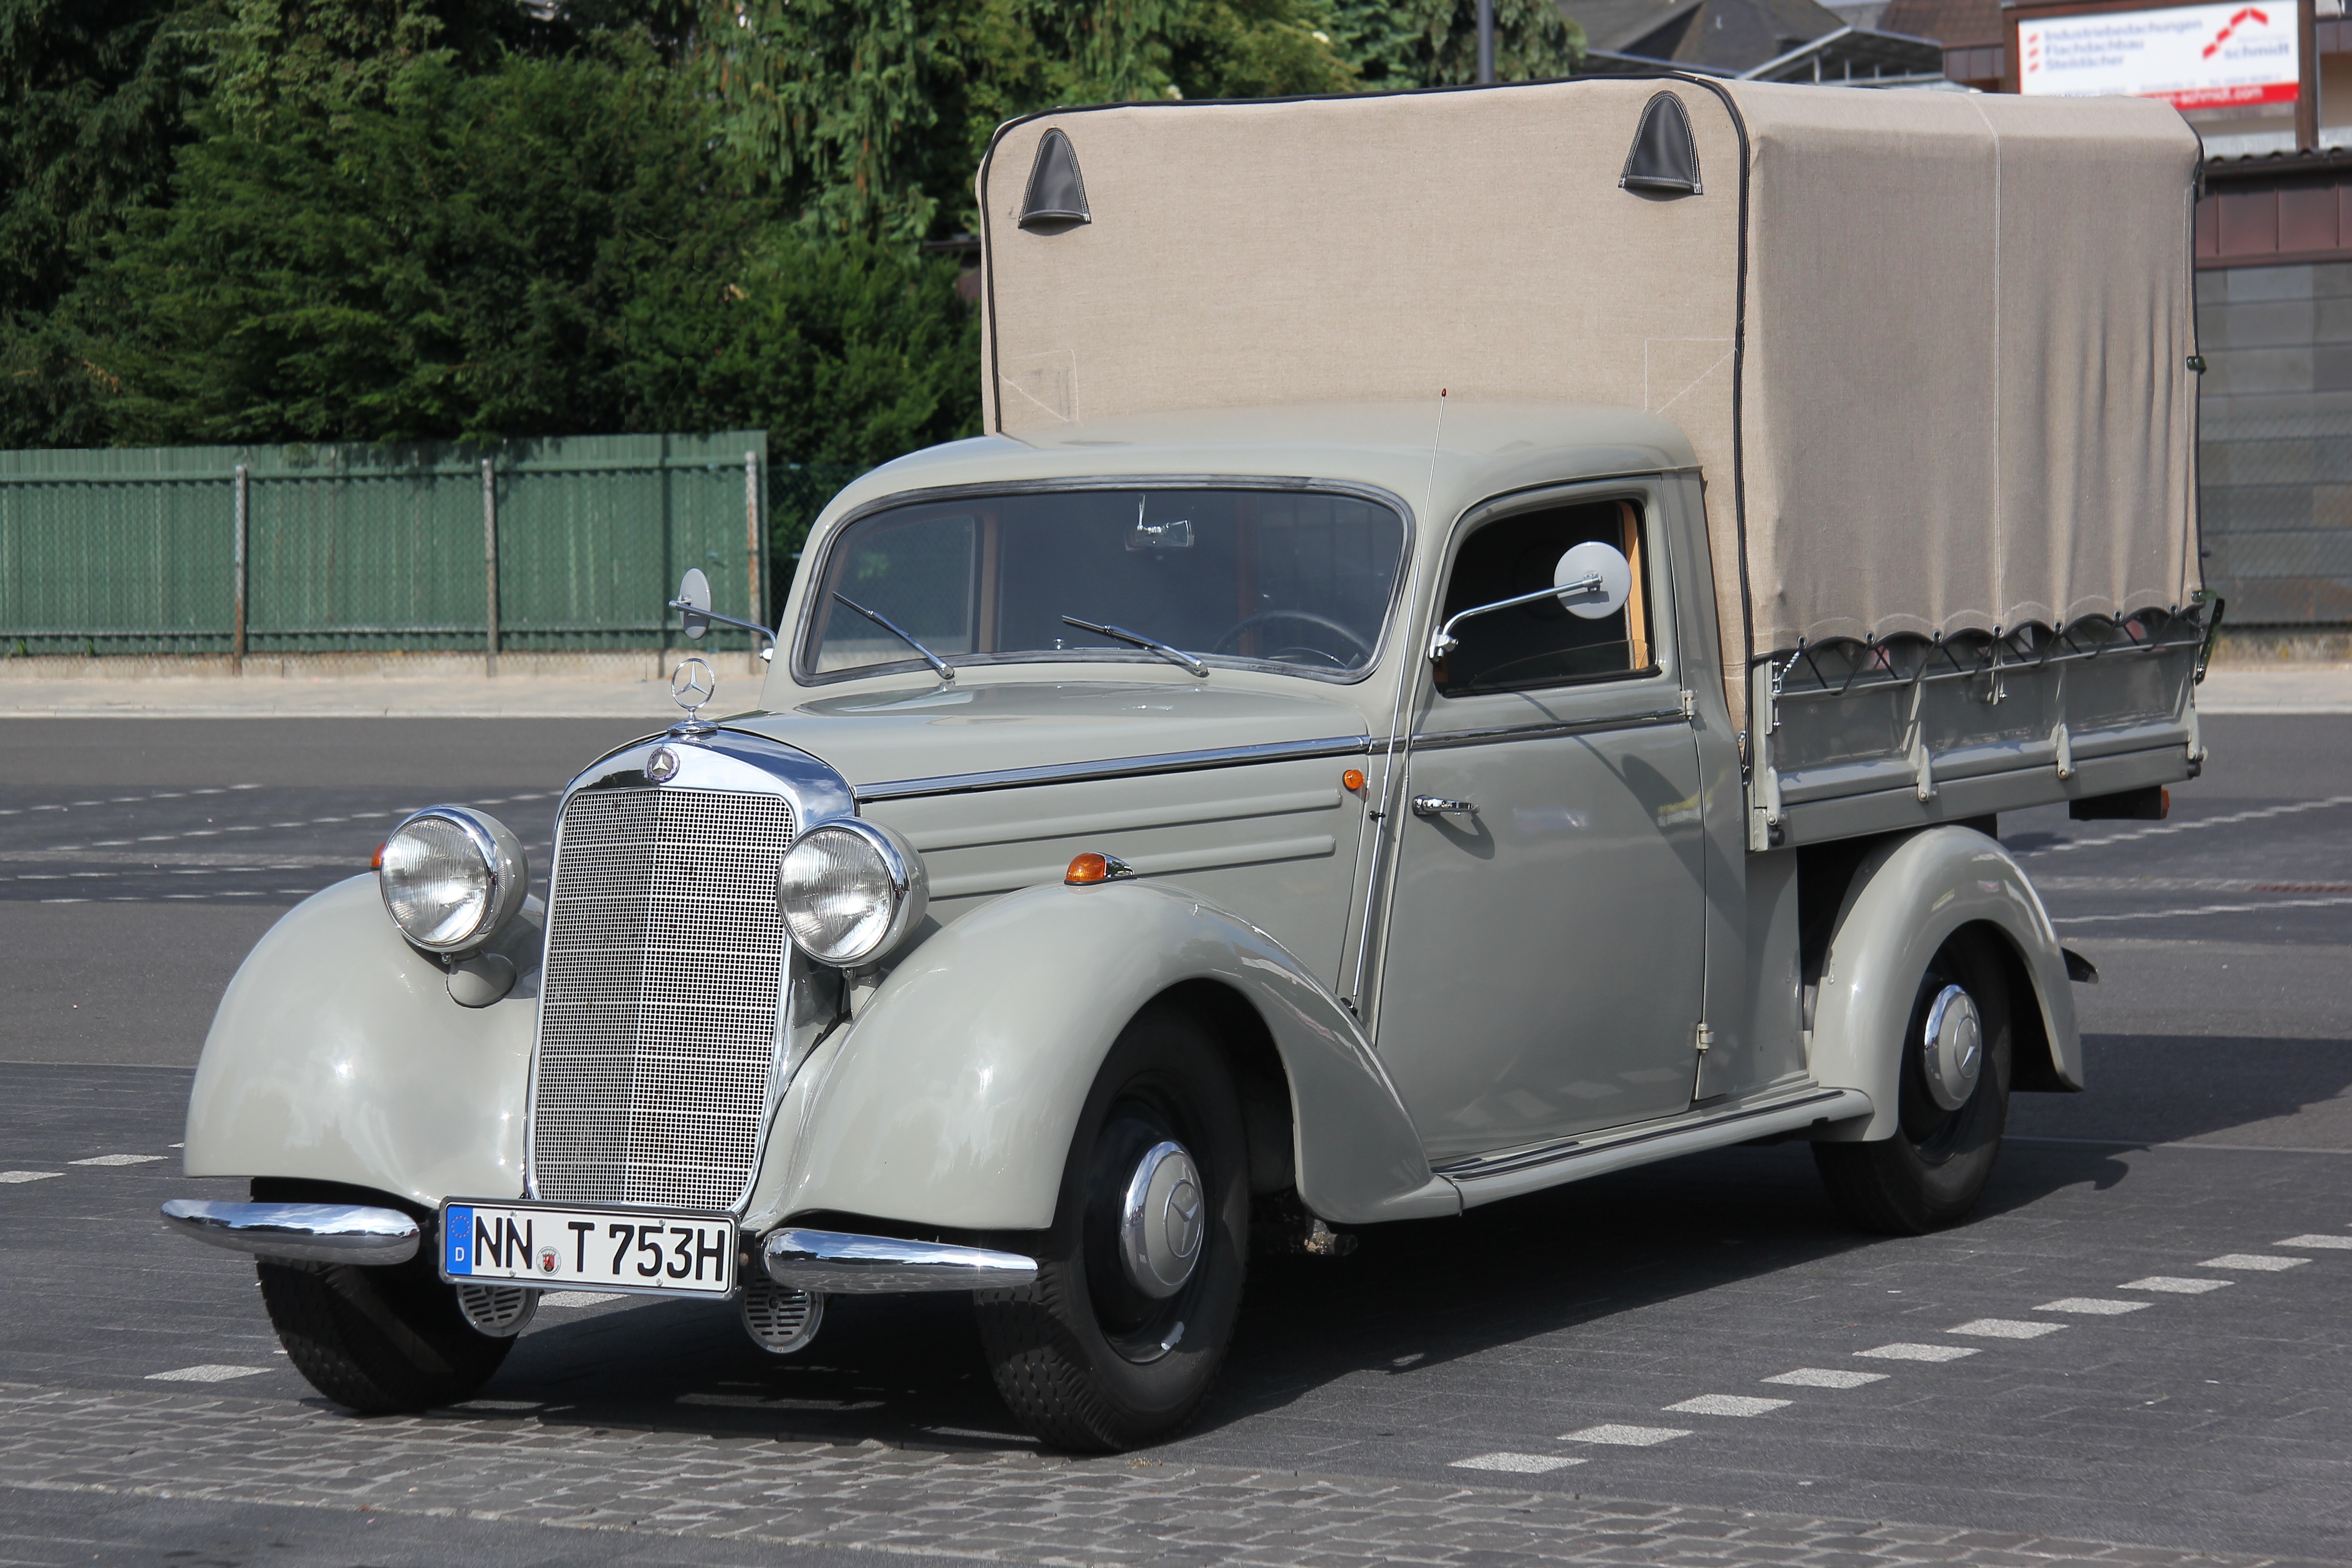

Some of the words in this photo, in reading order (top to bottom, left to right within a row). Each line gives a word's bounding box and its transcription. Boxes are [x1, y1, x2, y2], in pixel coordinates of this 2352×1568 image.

[2224, 42, 2289, 60] schmidt
[455, 1246, 465, 1262] D
[475, 1216, 533, 1270] NN
[568, 1221, 595, 1272] T
[610, 1224, 726, 1281] 753H
